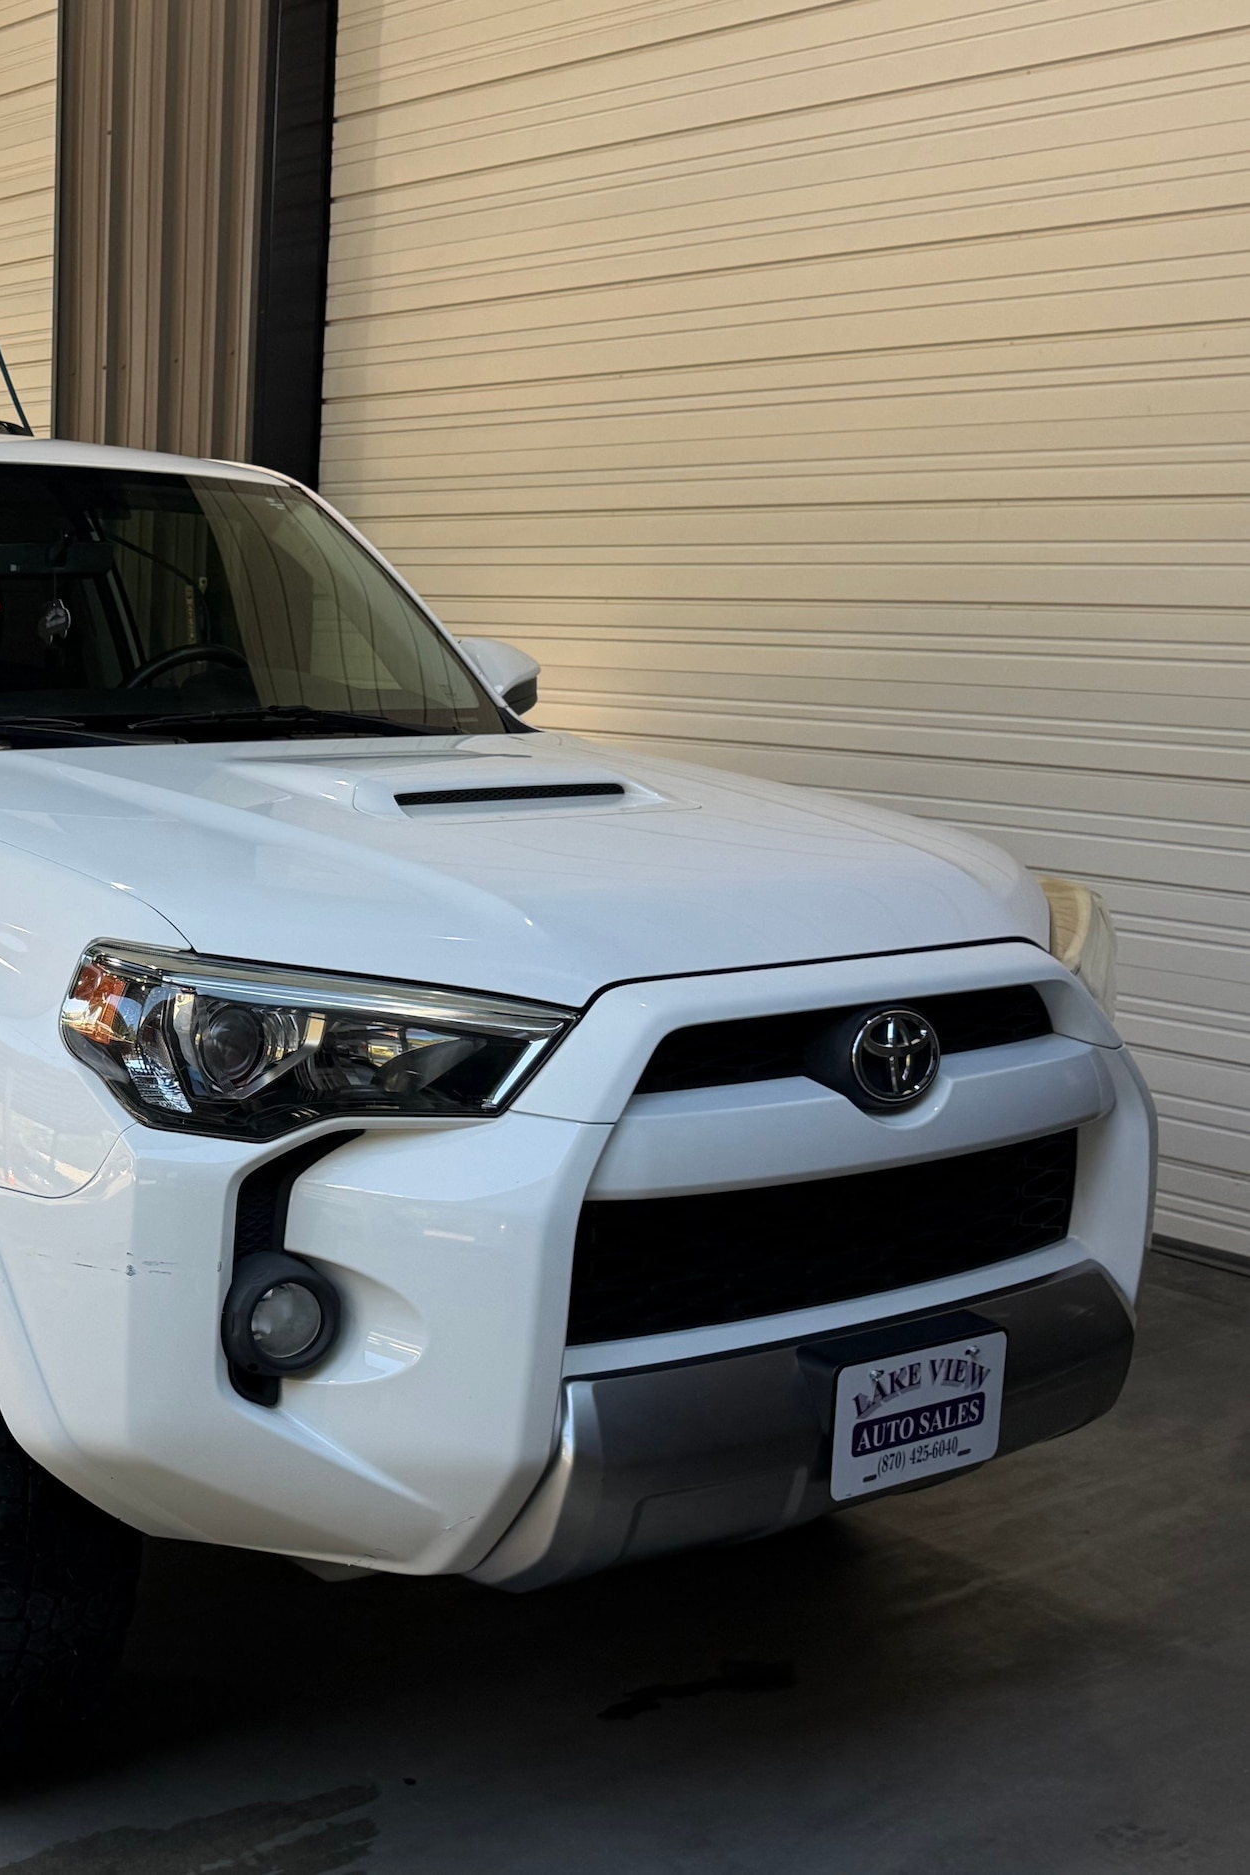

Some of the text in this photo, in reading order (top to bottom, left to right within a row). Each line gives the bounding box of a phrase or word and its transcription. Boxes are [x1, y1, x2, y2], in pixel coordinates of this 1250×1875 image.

[852, 1358, 991, 1419] LAKE VIEW
[856, 1400, 980, 1451] AUTO SALES
[877, 1437, 958, 1478] (870) 425-6040
